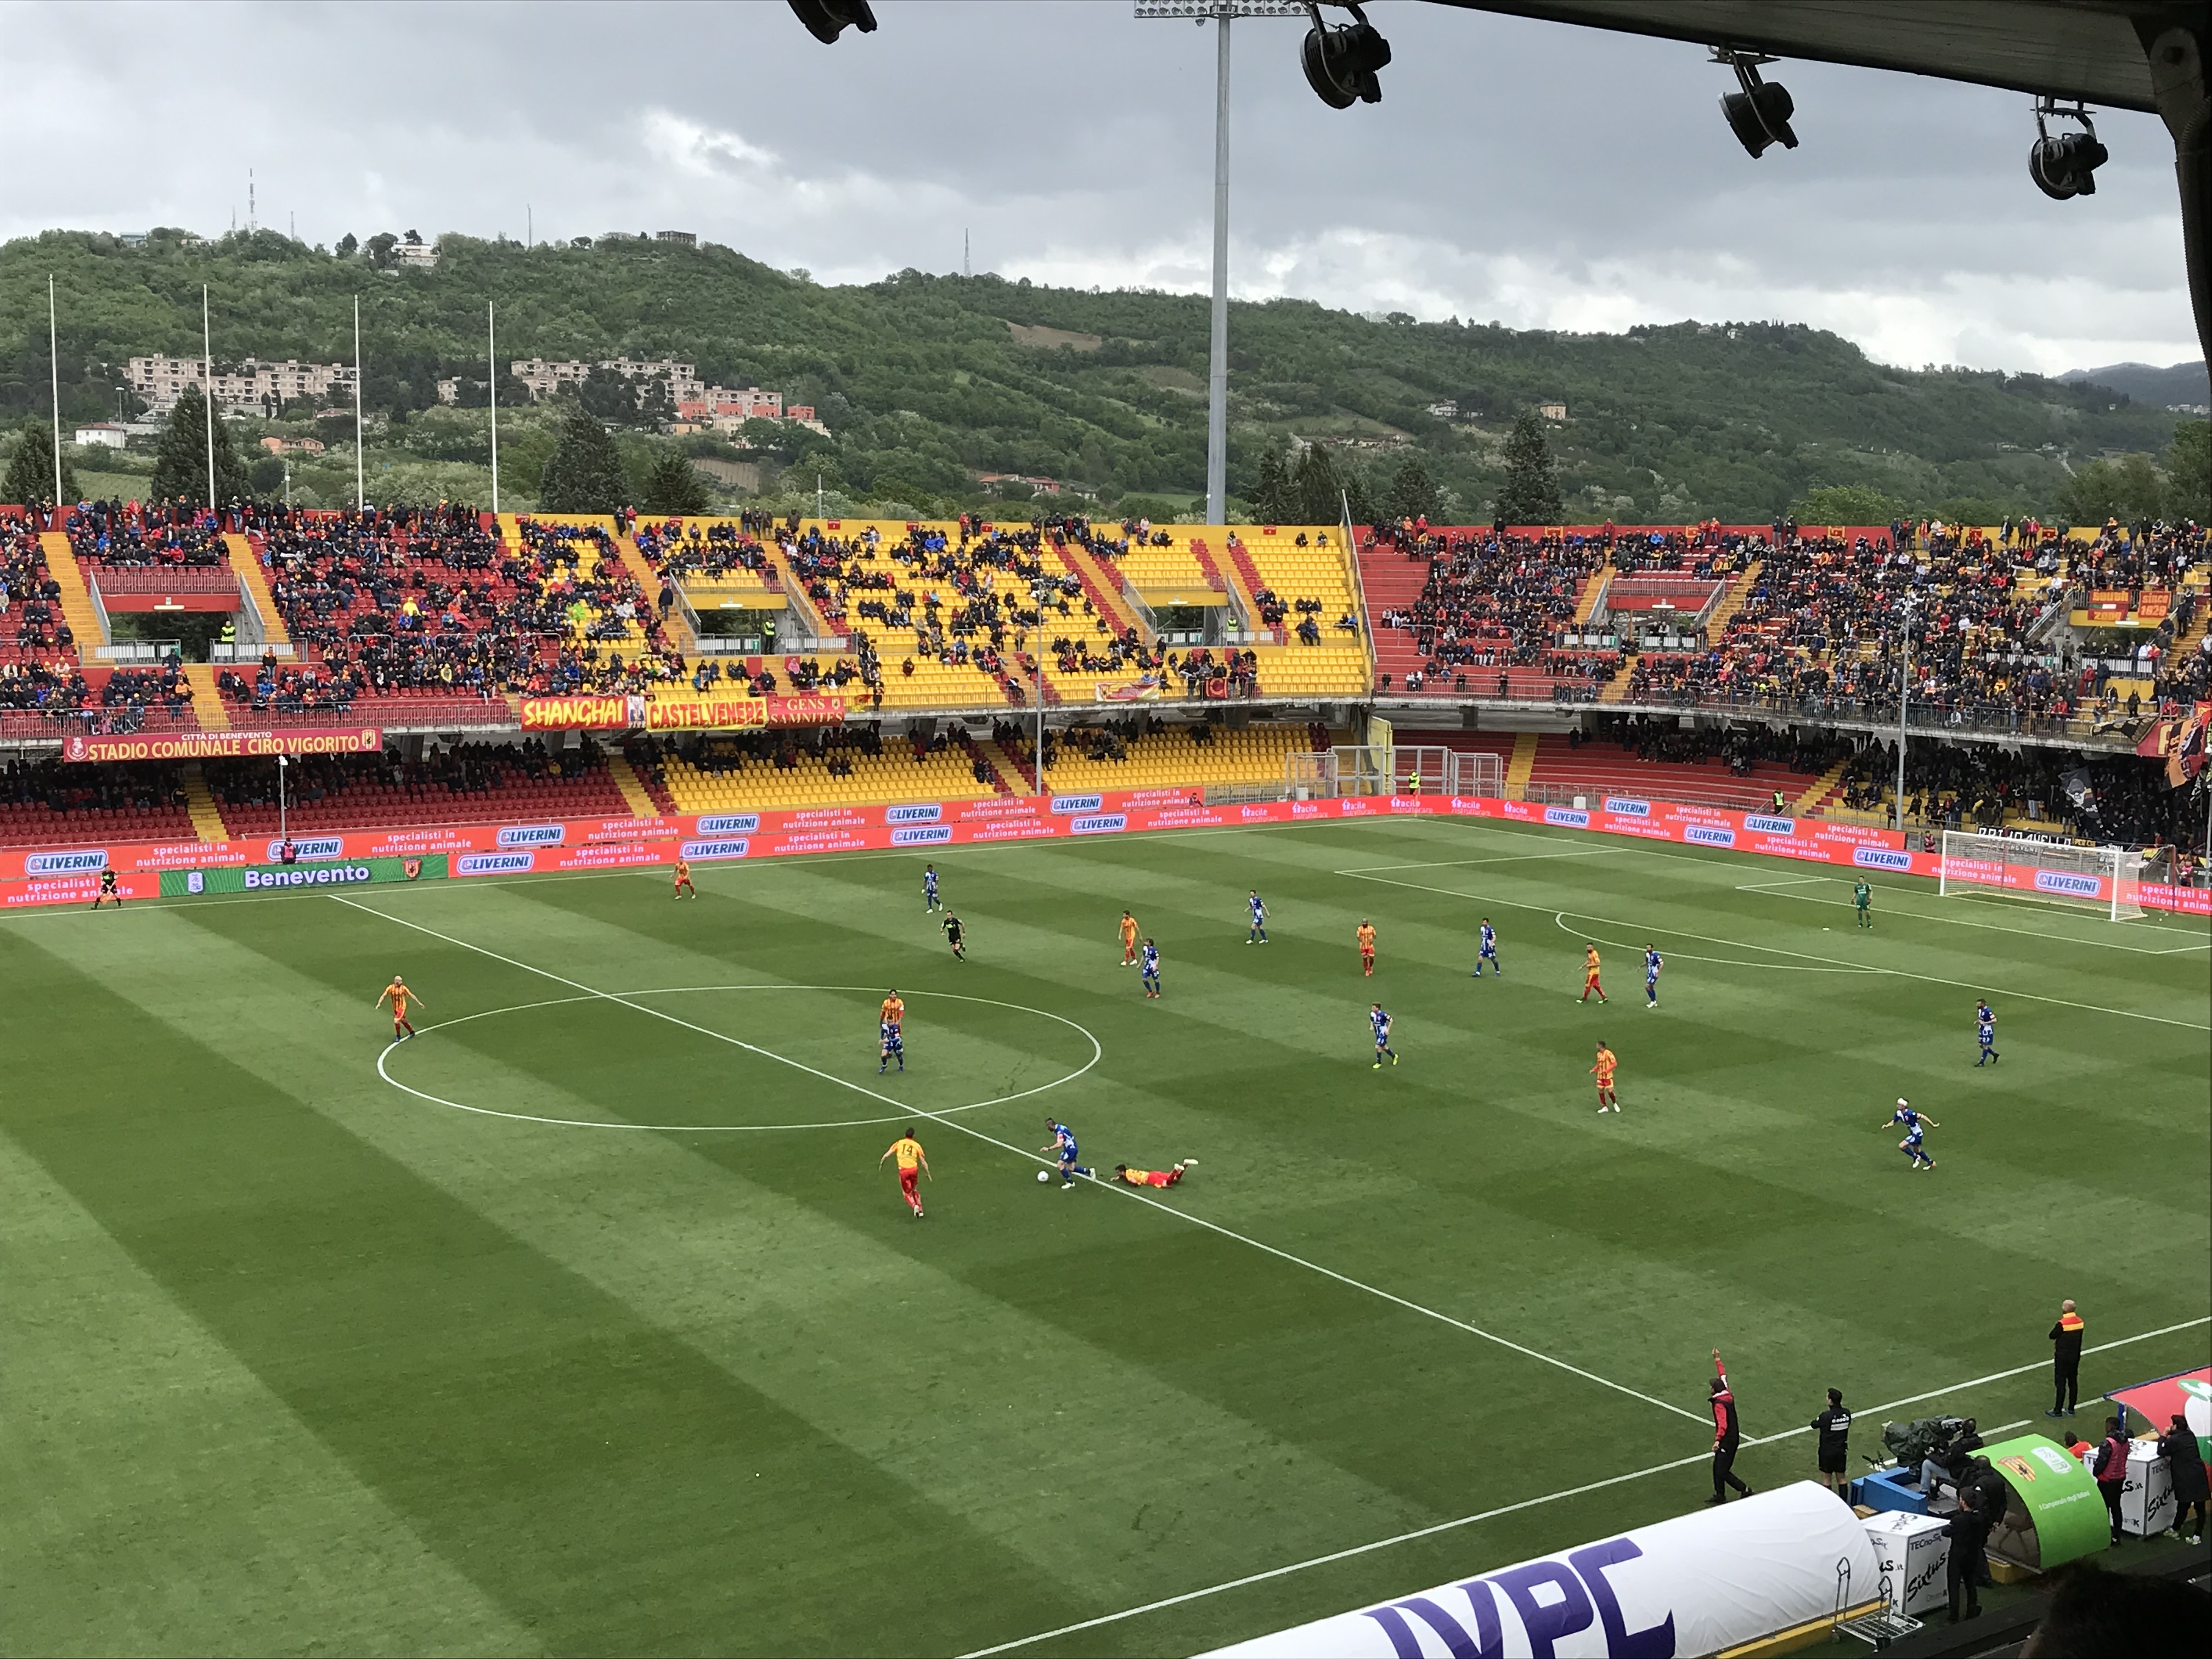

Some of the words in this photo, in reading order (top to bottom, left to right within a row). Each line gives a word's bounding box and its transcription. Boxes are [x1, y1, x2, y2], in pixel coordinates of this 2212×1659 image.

[787, 698, 825, 710] GENS
[523, 698, 624, 726] SHANGHAI
[650, 701, 764, 729] CASTELVENERE
[770, 712, 843, 724] SAMNITES
[181, 732, 206, 741] CITTÀ
[220, 732, 272, 740] BENEVENTO
[88, 742, 148, 760] STADIO
[151, 740, 241, 757] COMUNALE
[248, 738, 284, 754] CIRO
[286, 735, 359, 753] VIGORITO
[1133, 789, 1170, 799] specialisti
[973, 798, 1013, 809] specialisti
[1122, 799, 1159, 808] nutrizione
[1163, 797, 1190, 805] animale
[796, 810, 840, 821] specialisti
[961, 808, 1002, 817] nutrizione
[1160, 809, 1199, 819] specialisti
[1677, 806, 1712, 816] specialisti
[603, 819, 651, 830] specialisti
[655, 817, 664, 826] in
[783, 819, 828, 829] nutrizione
[831, 817, 865, 826] animale
[986, 820, 1029, 832] specialisti
[1148, 817, 1188, 827] nutrizione
[1615, 816, 1651, 826] specialisti
[1666, 814, 1700, 823] nutrizione
[1703, 818, 1731, 827] animale
[388, 831, 441, 843] specialisti
[445, 830, 455, 838] in
[588, 830, 637, 840] nutrizione
[641, 827, 678, 836] animale
[973, 829, 1018, 839] nutrizione
[1021, 827, 1054, 835] animale
[1605, 823, 1640, 833] nutrizione
[1643, 828, 1671, 837] animale
[1828, 824, 1867, 836] specialisti
[1871, 828, 1878, 837] in
[788, 832, 837, 843] specialisti
[1767, 836, 1807, 848] specialisti
[1810, 840, 1818, 849] in
[1815, 832, 1855, 843] nutrizione
[1858, 837, 1889, 848] animale
[154, 843, 212, 856] specialisti
[217, 843, 227, 851] in
[295, 842, 338, 855] VERINI
[372, 843, 426, 853] nutrizione
[430, 840, 471, 849] animale
[576, 845, 630, 858] specialisti
[775, 842, 823, 851] nutrizione
[827, 839, 865, 848] animale
[1755, 843, 1795, 855] nutrizione
[1798, 848, 1830, 859] animale
[137, 856, 198, 866] nutrizione
[201, 852, 245, 863] animale
[560, 856, 615, 866] nutrizione
[619, 853, 660, 862] animale
[1946, 859, 1991, 871] specialisti
[1994, 862, 2002, 872] in
[245, 865, 369, 887] Benevento
[1932, 866, 1978, 878] nurizione
[27, 878, 95, 893] specialisti
[8, 890, 76, 902] nutrizione
[82, 886, 133, 898] aniale
[2142, 885, 2195, 899] specialisti
[2199, 890, 2208, 900] in
[1908, 1552, 1946, 1602] Sixtus
